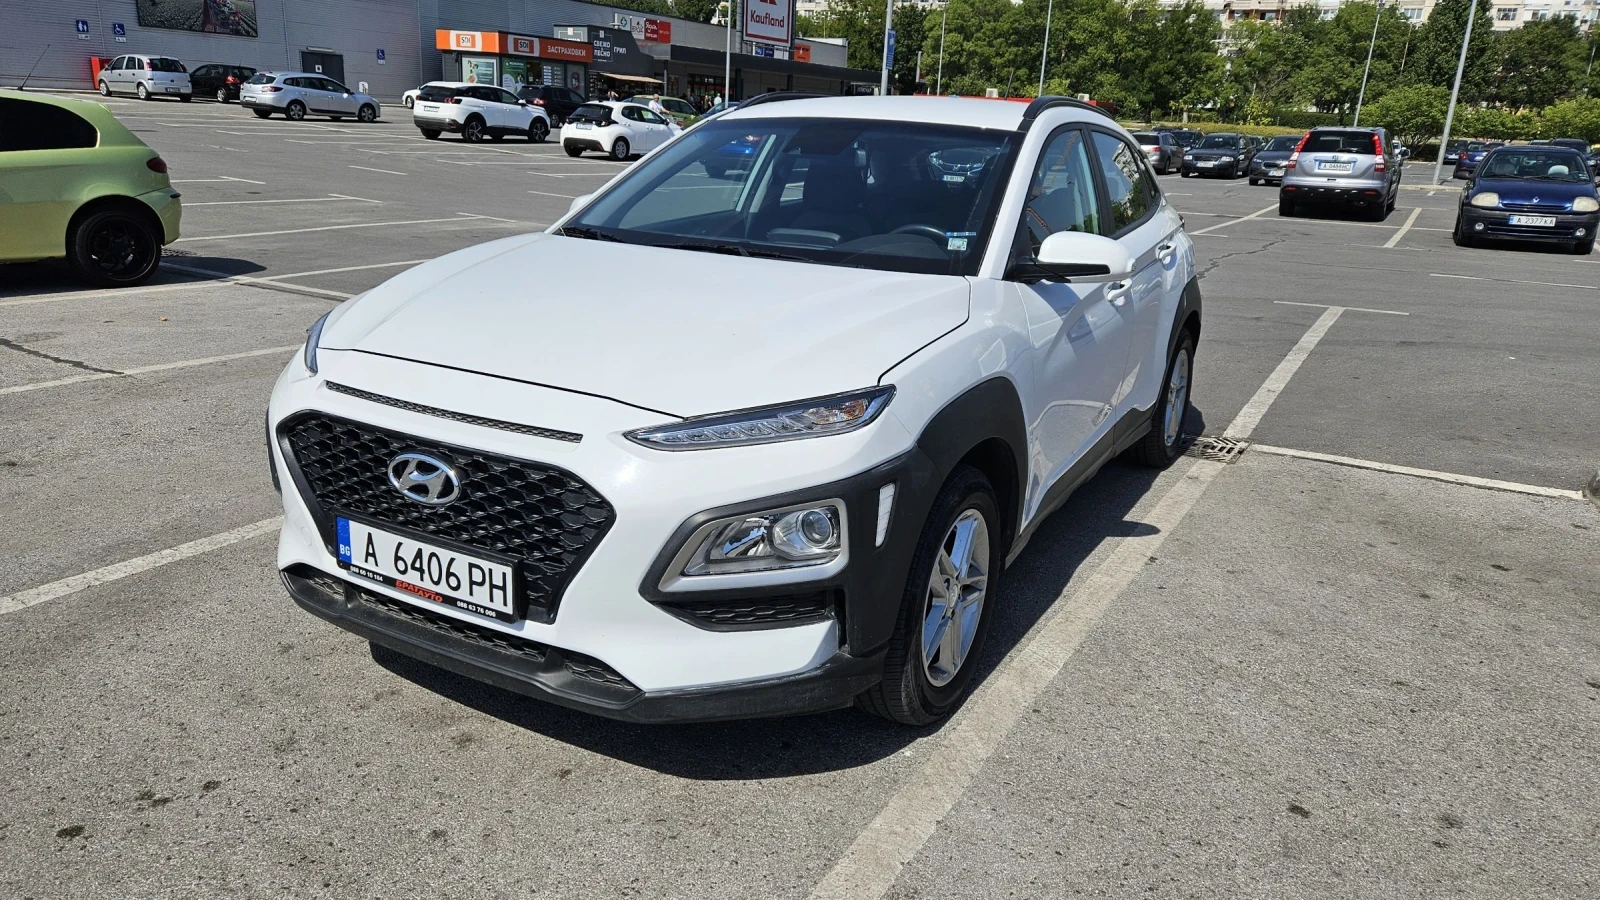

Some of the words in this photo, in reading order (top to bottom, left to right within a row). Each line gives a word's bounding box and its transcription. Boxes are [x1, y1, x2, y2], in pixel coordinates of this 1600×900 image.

[751, 10, 784, 27] Kaufland
[519, 41, 528, 49] SDI
[594, 40, 610, 48] СВЕЖО
[547, 46, 586, 56] ЗАСТРАХОВКИ
[340, 544, 350, 556] BG
[364, 532, 378, 567] A
